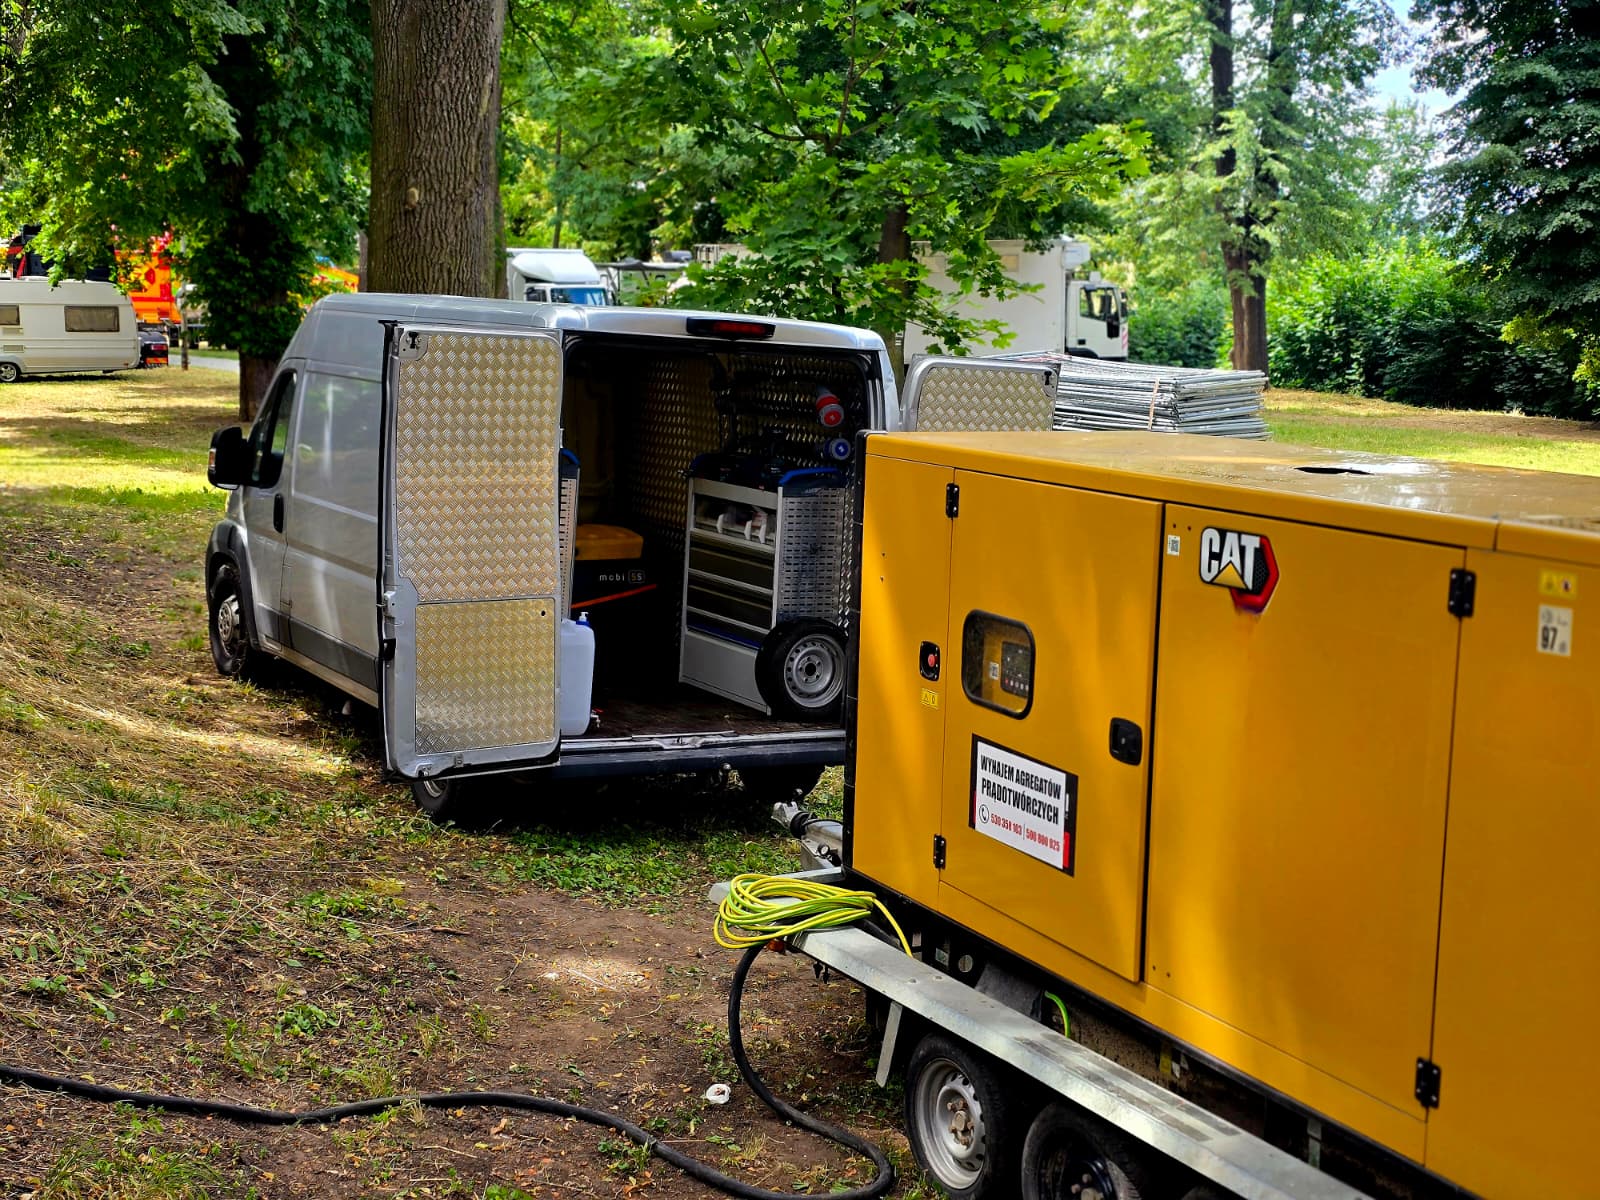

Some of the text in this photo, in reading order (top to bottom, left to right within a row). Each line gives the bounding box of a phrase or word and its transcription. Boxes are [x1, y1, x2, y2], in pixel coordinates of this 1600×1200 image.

[1201, 528, 1260, 590] CAT
[980, 755, 1062, 801] WYNAJEM AGREGATÓW
[981, 777, 1059, 825] PRĄDOTWÓRCZYCH
